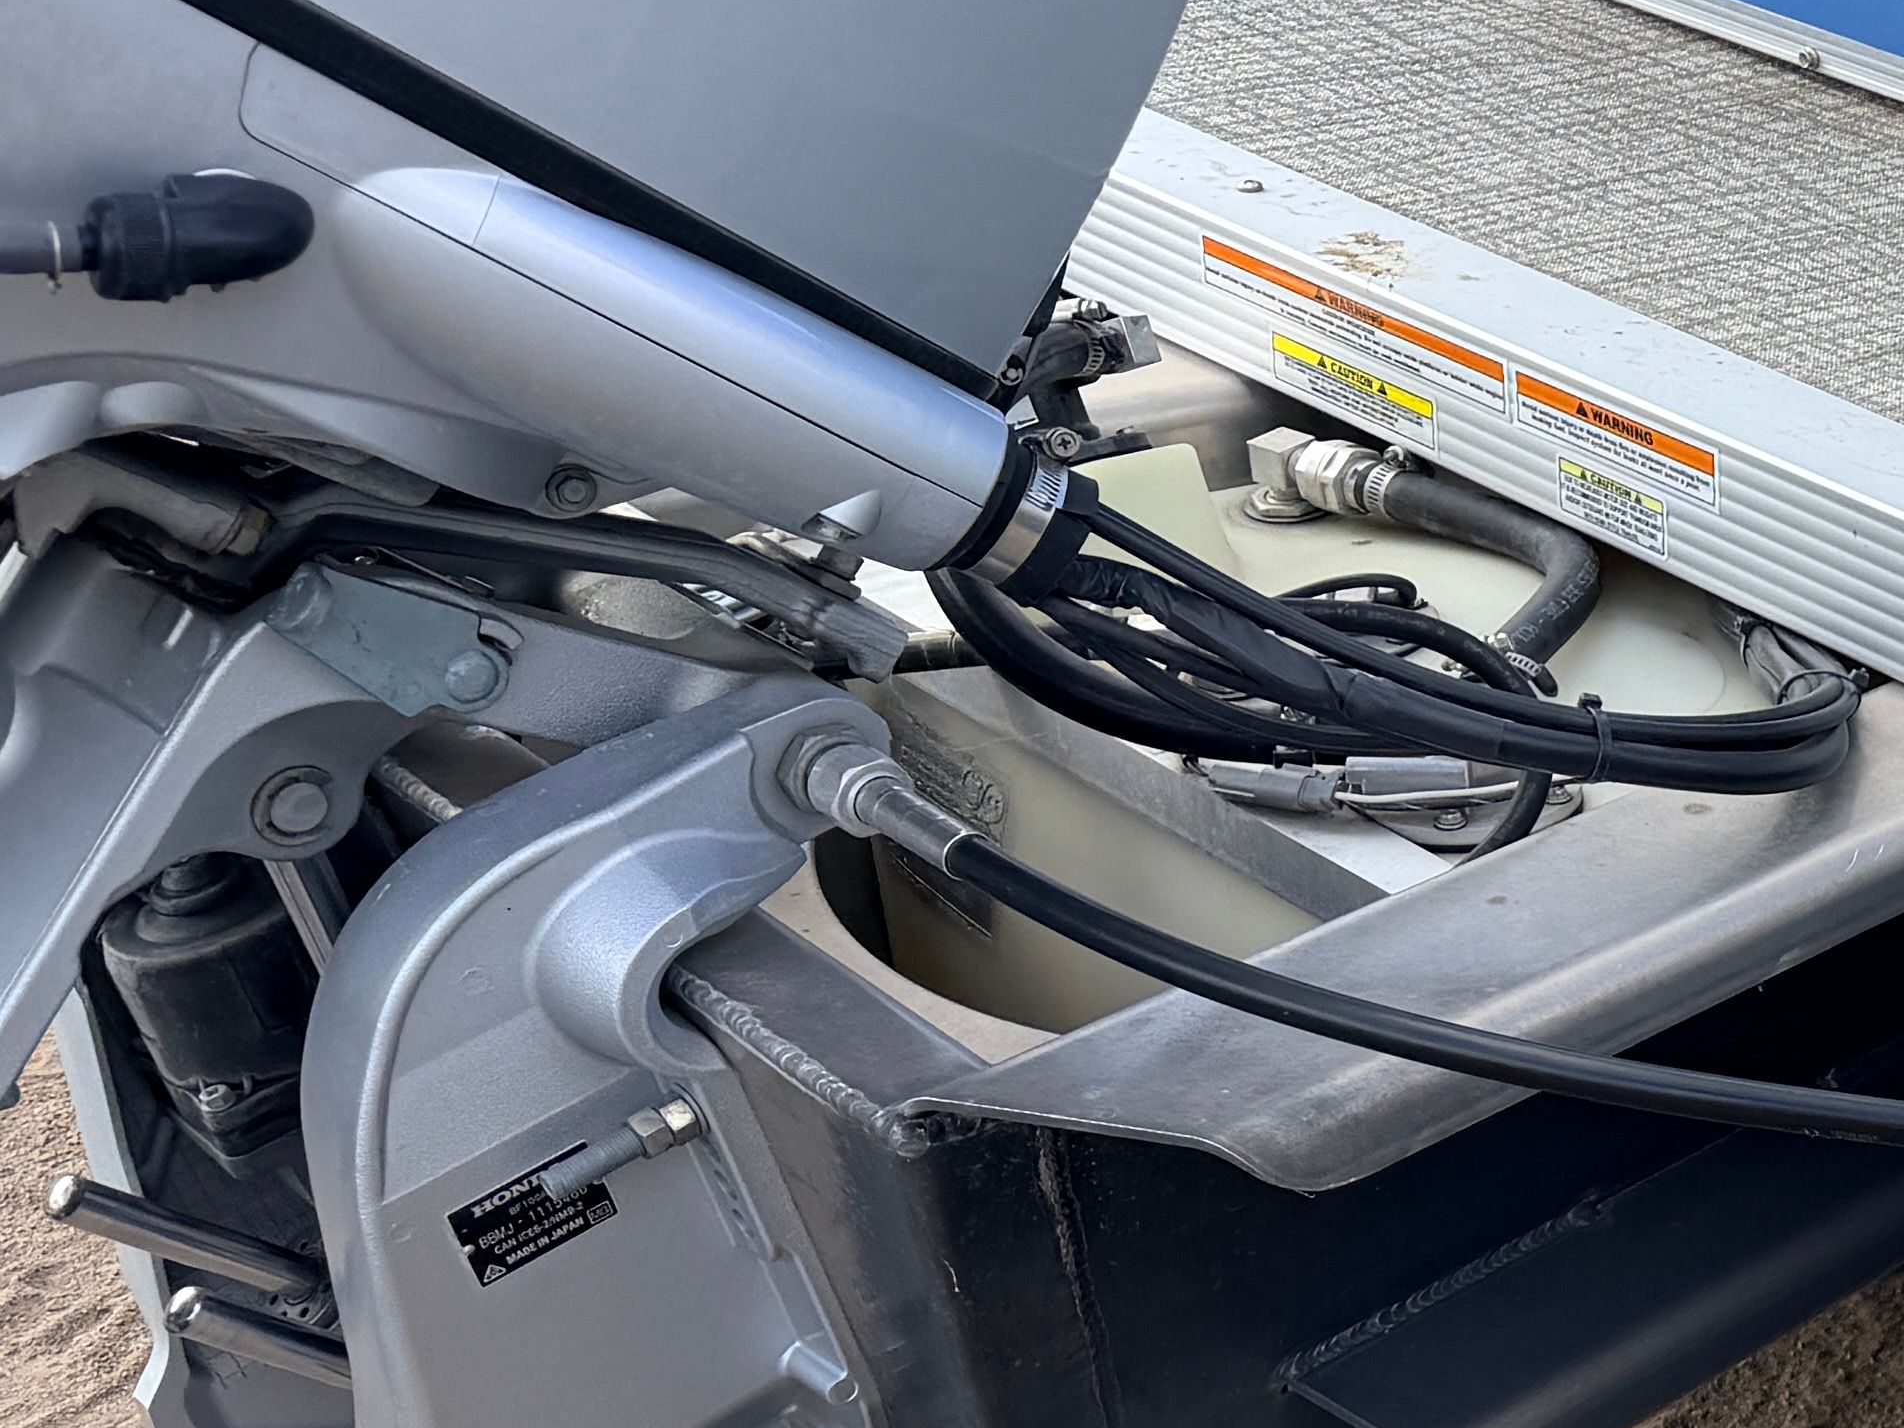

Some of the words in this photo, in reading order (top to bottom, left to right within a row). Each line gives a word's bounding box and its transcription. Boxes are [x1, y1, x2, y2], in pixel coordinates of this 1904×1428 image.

[1328, 293, 1385, 327] WARNING
[1330, 362, 1374, 389] CAUTION
[1591, 408, 1654, 446] WARNING
[1590, 473, 1631, 498] CAUTION
[470, 1174, 542, 1218] HON
[494, 1237, 517, 1255] CAN
[506, 1244, 538, 1265] MADE
[537, 1236, 549, 1247] IN
[551, 1217, 585, 1241] JAPAN
